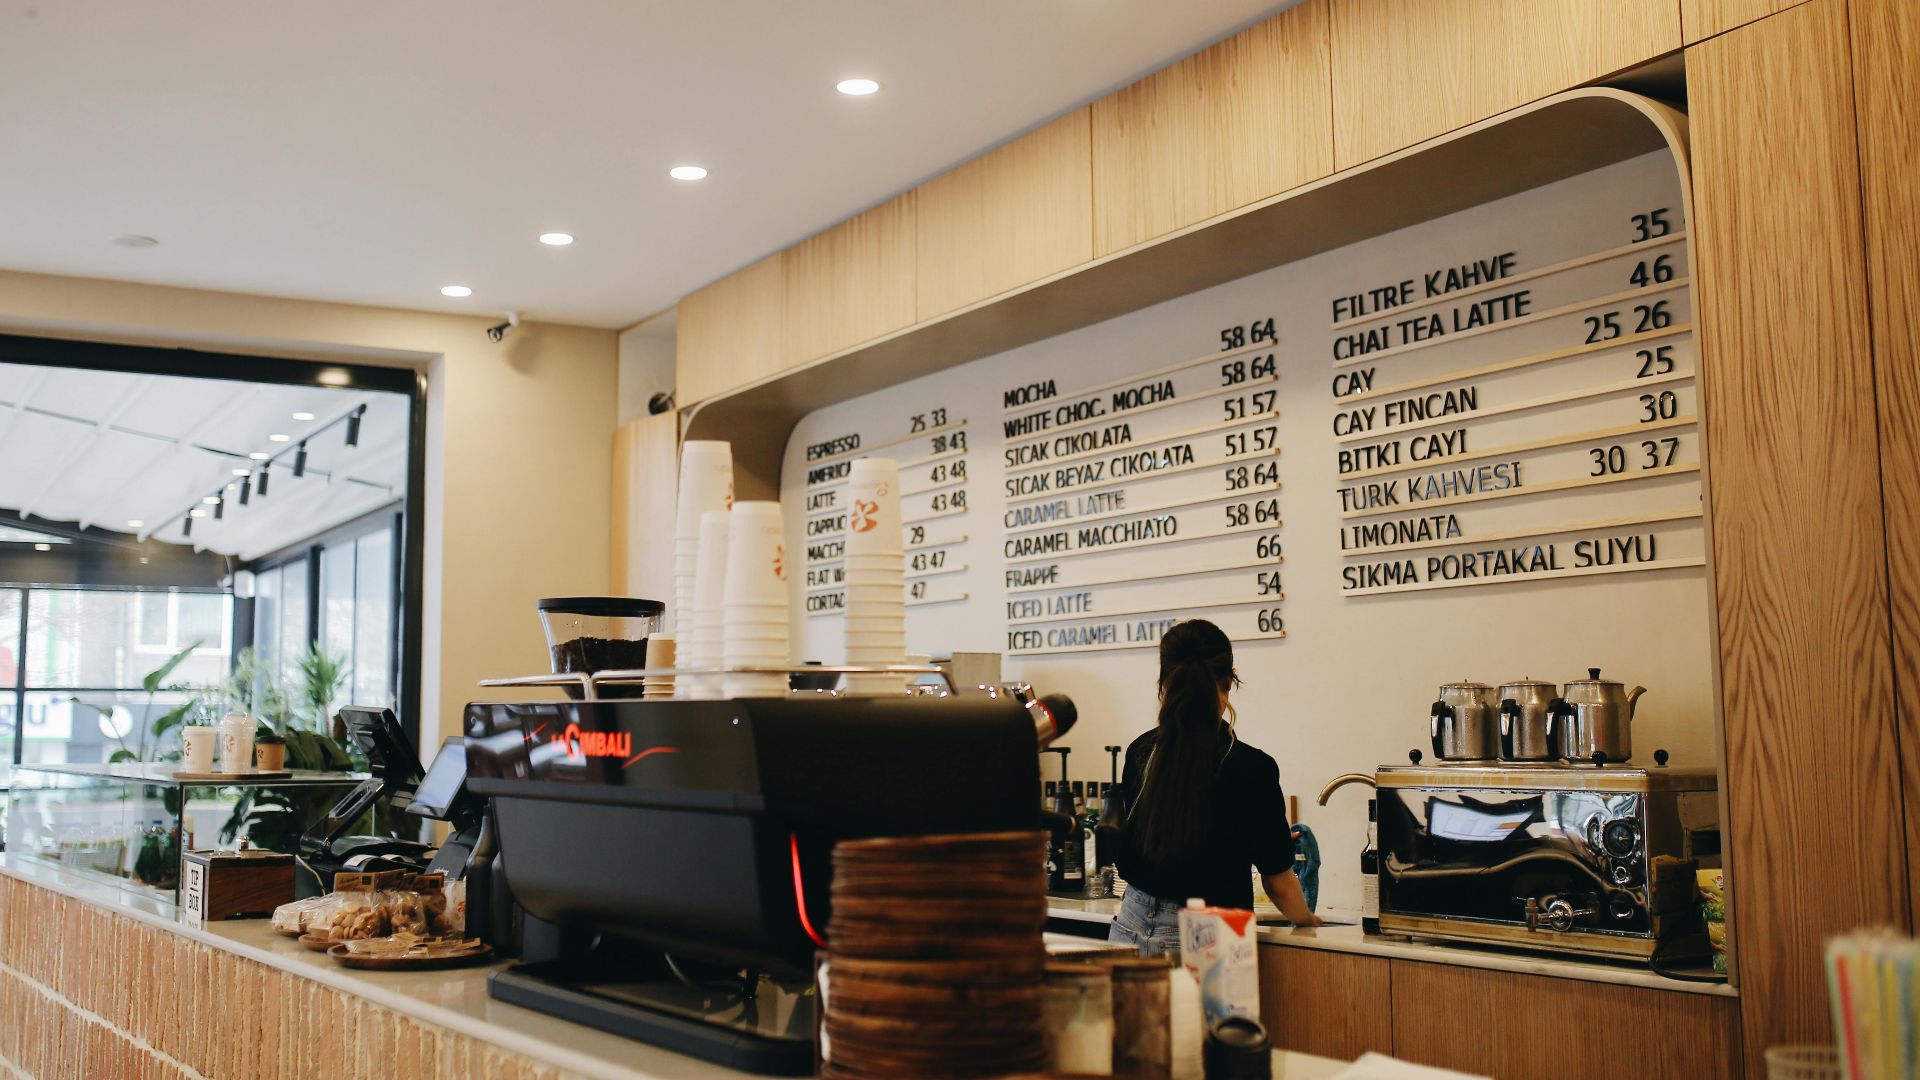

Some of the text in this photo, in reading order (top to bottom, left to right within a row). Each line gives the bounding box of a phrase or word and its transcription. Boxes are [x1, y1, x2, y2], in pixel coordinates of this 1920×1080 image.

[1332, 208, 1670, 323] FILTRE KAHVE 35
[1333, 254, 1674, 361] CHAI TEA LATTE 46
[1004, 318, 1276, 408] MOCHA 58 64
[1332, 300, 1672, 398] CAY 25 26
[1004, 354, 1276, 439] WHITE CHOC. MOCHA 58 64
[1333, 346, 1674, 438] CAY FINCAN 25
[807, 408, 947, 461] ESPRESSO 25 33
[931, 436, 947, 455] 38
[950, 431, 966, 450] 43
[1005, 390, 1277, 468] SICAK CIKOLATA 51 57
[1338, 390, 1677, 474] BITKI CAYI 30
[807, 460, 966, 511] LATTE 43 48
[1005, 426, 1278, 498] SICAK BEYAZ CIKOLATA 51 57
[1337, 437, 1680, 512] TURK KAHVESI 30 37
[808, 490, 966, 537] CAPPUC 43 48
[1004, 462, 1279, 528] CARAMEL LATTE 58 64
[910, 526, 924, 544] 29
[1004, 498, 1280, 558] CARAMEL MACCHIATO 58 64
[1340, 514, 1462, 550] LIMONATA
[807, 569, 830, 586] FLAT
[912, 554, 926, 571] 43
[930, 551, 946, 568] 47
[1006, 534, 1282, 588] FRAPPE 66
[1342, 534, 1656, 590] SIKMA PORTAKAL SUYU
[911, 582, 926, 600] 47
[1006, 571, 1282, 620] ICED LATTE 54
[1008, 631, 1042, 650] ICED
[1047, 625, 1117, 648] CARAMEL
[1258, 608, 1283, 632] 66
[188, 893, 200, 912] BOX
[191, 869, 199, 886] TIP
